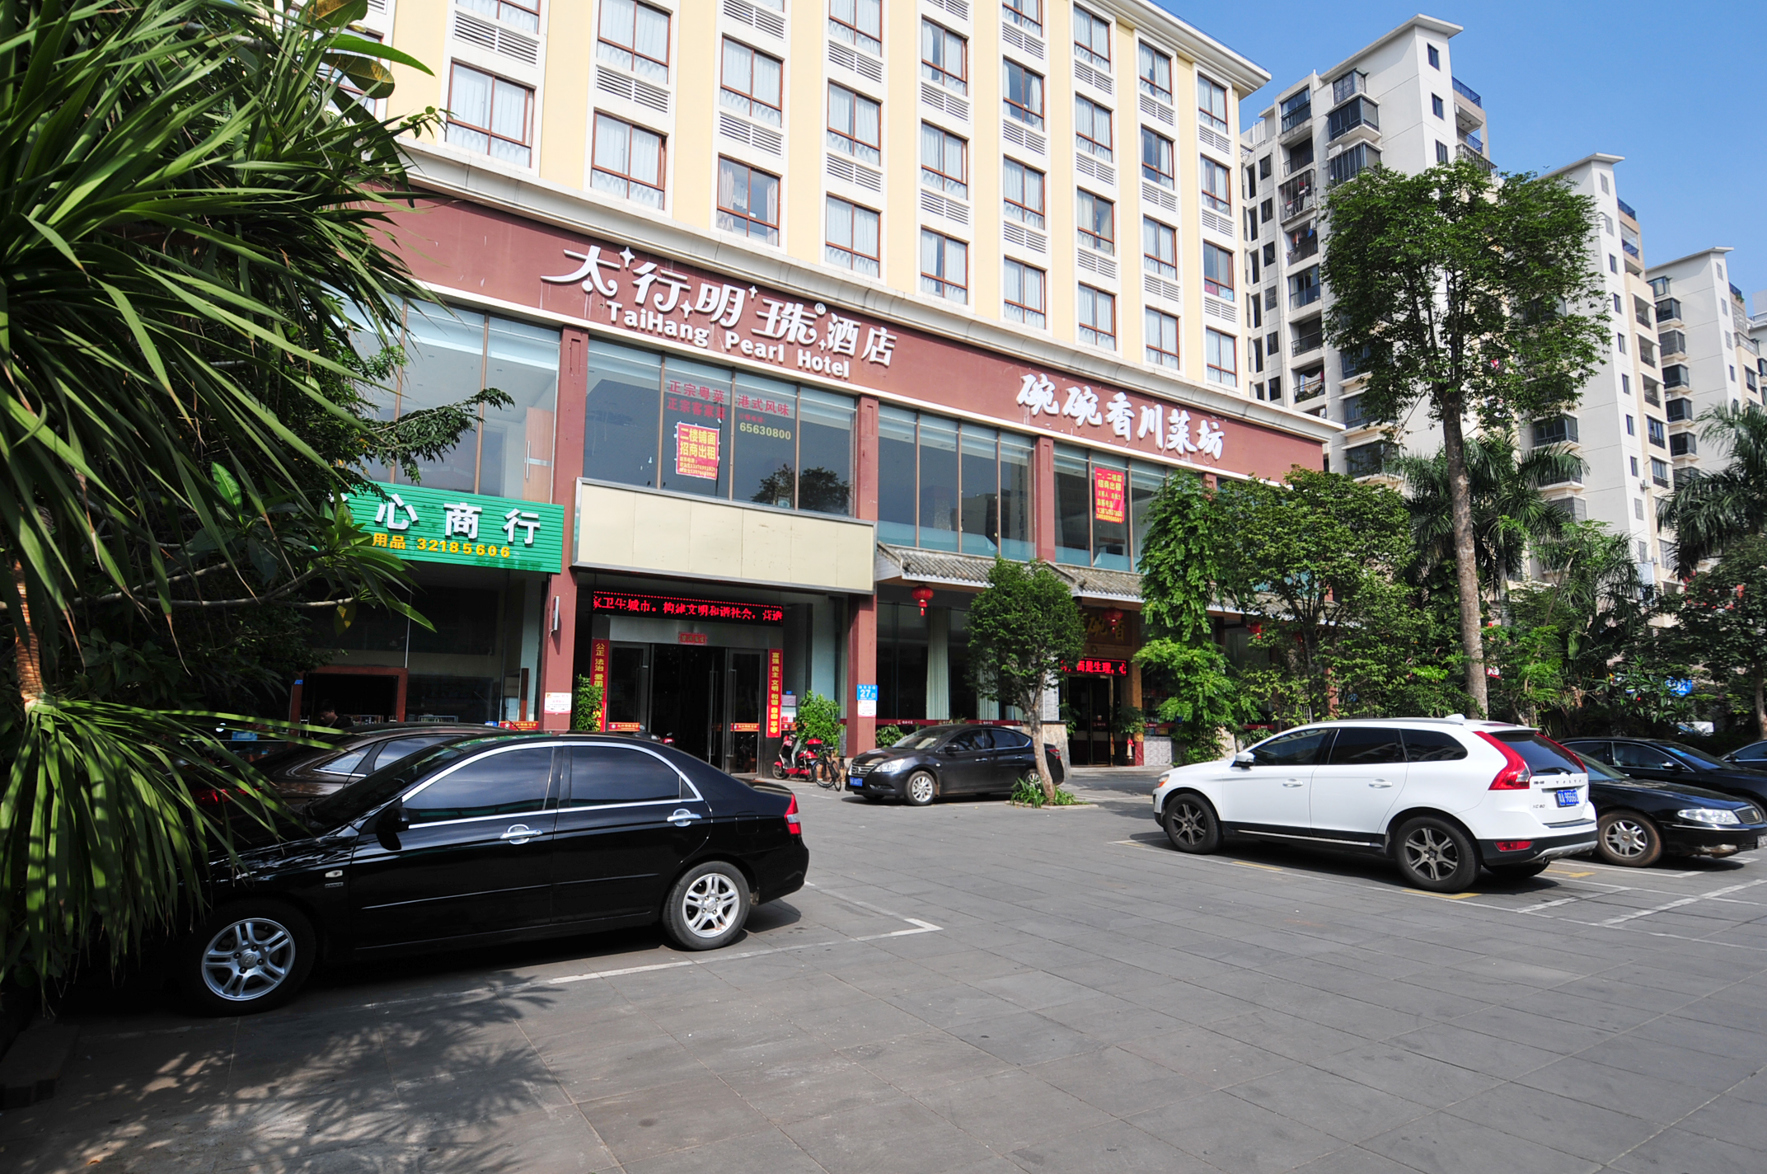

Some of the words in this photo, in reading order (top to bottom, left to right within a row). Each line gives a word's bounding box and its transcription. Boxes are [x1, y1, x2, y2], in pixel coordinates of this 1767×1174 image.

[540, 245, 897, 367] 太行明珠酒店
[606, 300, 710, 348] TaiHang
[725, 330, 784, 364] Pearl
[797, 350, 850, 378] Hotel
[668, 380, 725, 404] 正宗粤菜
[737, 394, 790, 416] 港式风味
[1016, 373, 1225, 460] 碗碗香川菜坊
[739, 422, 792, 440] 65630800
[680, 440, 717, 460] 招商出租
[416, 537, 510, 558] 32185606
